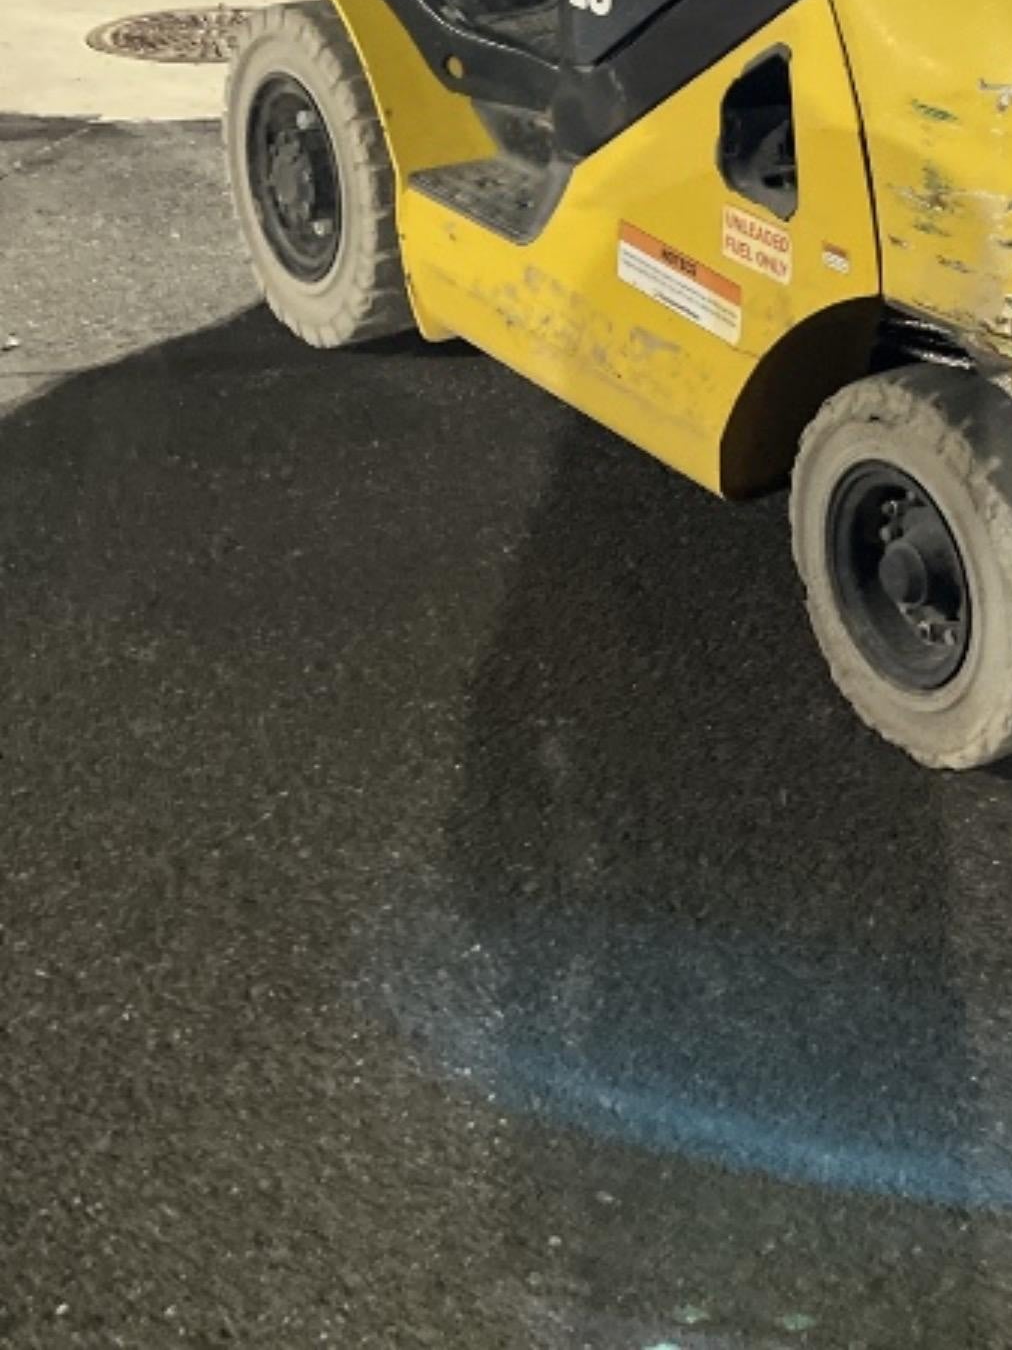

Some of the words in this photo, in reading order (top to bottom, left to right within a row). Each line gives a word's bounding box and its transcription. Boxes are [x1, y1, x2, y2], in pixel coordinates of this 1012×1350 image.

[725, 209, 790, 253] UNLEADED
[725, 233, 754, 262] FUEL
[755, 250, 788, 277] ONLY
